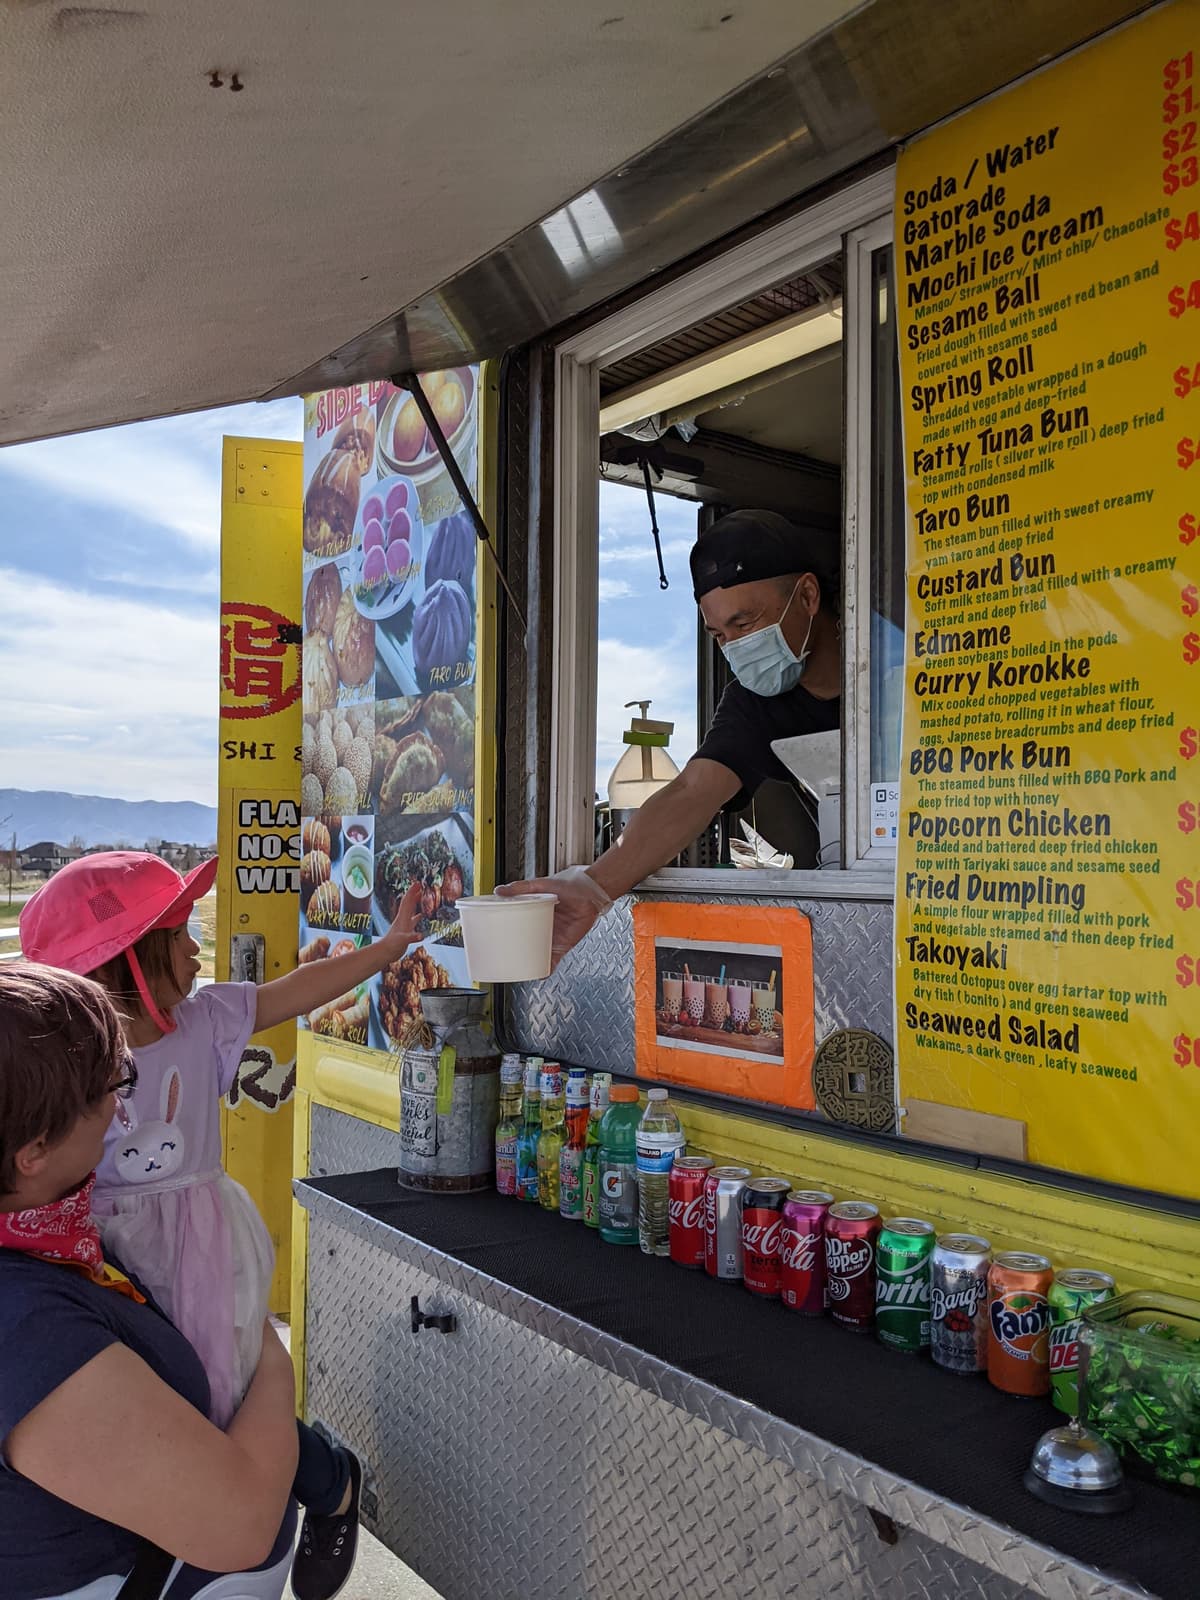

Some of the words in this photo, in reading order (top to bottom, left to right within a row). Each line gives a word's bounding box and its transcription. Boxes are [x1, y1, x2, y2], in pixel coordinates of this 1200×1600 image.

[1163, 85, 1200, 123] $1.
[904, 176, 956, 215] Soda
[986, 127, 1059, 178] Water
[904, 184, 1005, 245] Gatorade
[905, 223, 986, 276] Marble
[993, 195, 1050, 236] Soda
[908, 257, 976, 307] Mochi
[982, 246, 1014, 275] Ice
[1022, 206, 1103, 256] Cream
[914, 292, 957, 320] Mango/
[960, 261, 1029, 301] Strawberry/
[1032, 249, 1062, 271] Mint
[1066, 233, 1099, 257] chip/
[908, 302, 988, 350] Sesame
[995, 275, 1040, 314] Ball
[918, 355, 958, 380] covered
[960, 346, 984, 365] with
[987, 332, 1028, 355] sesame
[1031, 318, 1057, 339] seed
[911, 370, 982, 414] Spring
[988, 346, 1033, 386] Roll
[922, 401, 970, 428] Shredded
[972, 384, 1024, 411] vegetable
[1027, 364, 1078, 393] wrapped
[1082, 362, 1093, 375] in
[1097, 359, 1104, 370] a
[1107, 344, 1147, 365] dough
[316, 384, 364, 439] SIDE
[913, 442, 970, 476] Fatty
[977, 424, 1033, 455] Tuna
[1040, 406, 1088, 438] Bun
[922, 491, 939, 504] top
[941, 482, 964, 499] with
[967, 464, 1025, 492] condensed
[1028, 458, 1054, 476] milk
[914, 507, 960, 535] Taro
[966, 494, 1009, 522] Bun
[923, 538, 942, 552] The
[945, 531, 976, 547] steam
[978, 526, 999, 539] bun
[1001, 514, 1030, 533] filled
[1034, 507, 1061, 525] with
[1064, 499, 1100, 519] sweet
[1103, 489, 1154, 510] creamy
[917, 560, 1003, 599] Custard
[1010, 554, 1055, 581] Bun
[914, 625, 1011, 657] Edmame
[924, 657, 955, 670] Green
[958, 650, 1008, 667] soybeans
[1011, 641, 1046, 659] boiled
[1049, 641, 1060, 653] in
[1064, 637, 1084, 651] the
[1087, 631, 1117, 651] pods
[430, 665, 451, 684] TARO
[455, 662, 475, 680] BUN
[914, 671, 981, 696] Curry
[988, 654, 1090, 689] Korokke
[921, 699, 944, 712] Mix
[946, 694, 985, 710] cooked
[988, 688, 1036, 707] chopped
[1040, 682, 1106, 702] vegetables
[1109, 678, 1139, 694] with
[919, 735, 944, 747] eggs,
[947, 730, 991, 745] Japnese
[994, 721, 1074, 740] breadcrumbs
[1078, 718, 1102, 733] and
[1106, 717, 1136, 732] deep
[1140, 712, 1174, 728] fried
[221, 740, 276, 761] SHI
[910, 748, 953, 775] BBQ
[960, 745, 1014, 773] Pork
[1022, 743, 1070, 769] Bun
[238, 799, 301, 828] FLA
[918, 796, 941, 810] deep
[944, 794, 970, 807] fried
[973, 795, 991, 809] top
[994, 792, 1020, 806] with
[1023, 792, 1059, 807] honey
[237, 833, 282, 861] NO
[284, 833, 301, 861] S
[908, 812, 1000, 846] Popcorn
[1008, 809, 1110, 836] Chicken
[916, 838, 959, 853] Breaded
[962, 840, 983, 853] and
[986, 840, 1035, 853] battered
[1039, 840, 1067, 856] deep
[1070, 840, 1101, 853] fried
[1104, 839, 1157, 854] chicken
[235, 865, 301, 894] WIT
[906, 872, 960, 901] Fried
[967, 874, 1085, 914] Dumpling
[913, 903, 921, 916] A
[924, 904, 958, 920] simple
[961, 905, 989, 919] flour
[992, 906, 1044, 924] wrapped
[1048, 909, 1081, 924] filled
[1084, 912, 1113, 926] with
[1117, 913, 1150, 930] pork
[905, 936, 1007, 971] Takoyaki
[912, 968, 958, 985] Battered
[960, 973, 1005, 991] Octopus
[1008, 981, 1034, 993] over
[1037, 984, 1059, 998] egg
[1062, 984, 1104, 1000] tartar
[1108, 988, 1131, 1006] top
[1135, 991, 1167, 1006] with
[348, 1024, 368, 1045] ROLL
[905, 1002, 1001, 1042] Seaweed
[1008, 1016, 1079, 1054] Salad
[705, 1189, 717, 1236] Coke
[830, 1238, 852, 1258] Dr
[932, 1278, 987, 1321] Barq's
[990, 1300, 1050, 1343] Fant
[1050, 1343, 1079, 1370] DE
